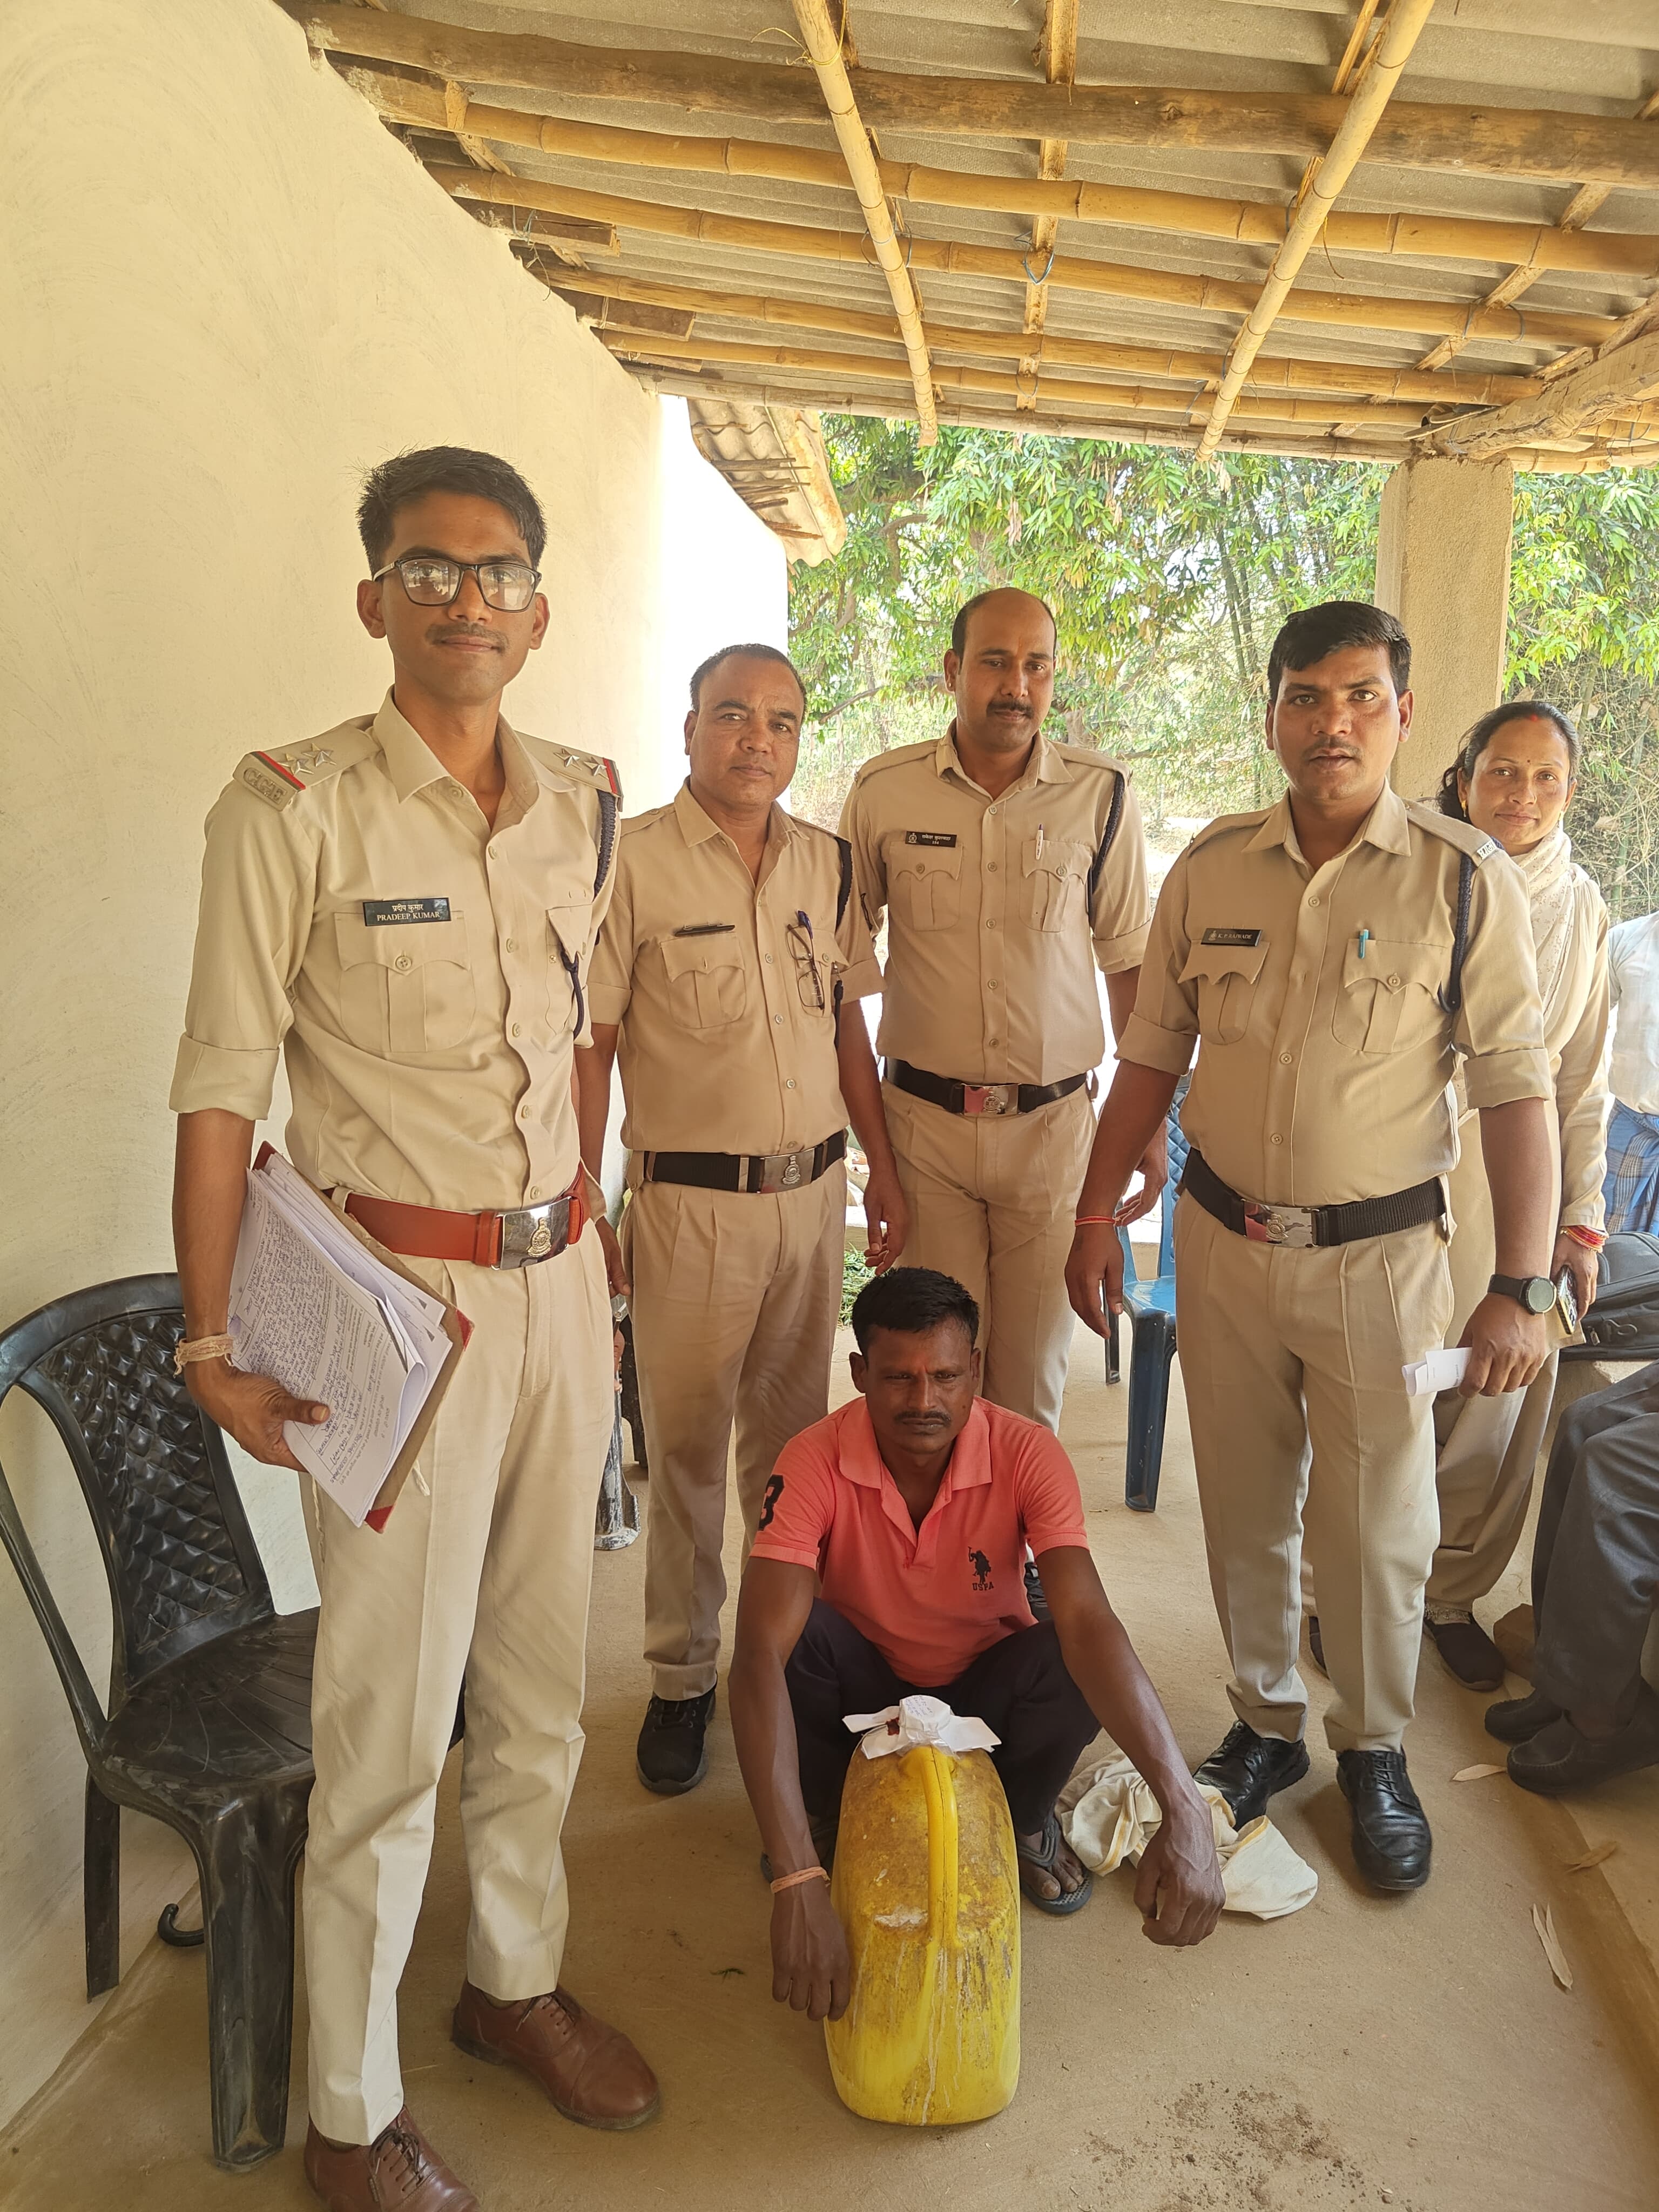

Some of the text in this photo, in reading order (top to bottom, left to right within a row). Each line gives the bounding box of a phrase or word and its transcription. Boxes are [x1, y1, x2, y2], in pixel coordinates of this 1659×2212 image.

[392, 903, 424, 913] प्रदीप कुमार
[377, 911, 441, 921] PRADEEP KUMAR
[758, 1474, 785, 1531] 3
[972, 1581, 994, 1590] USPA
